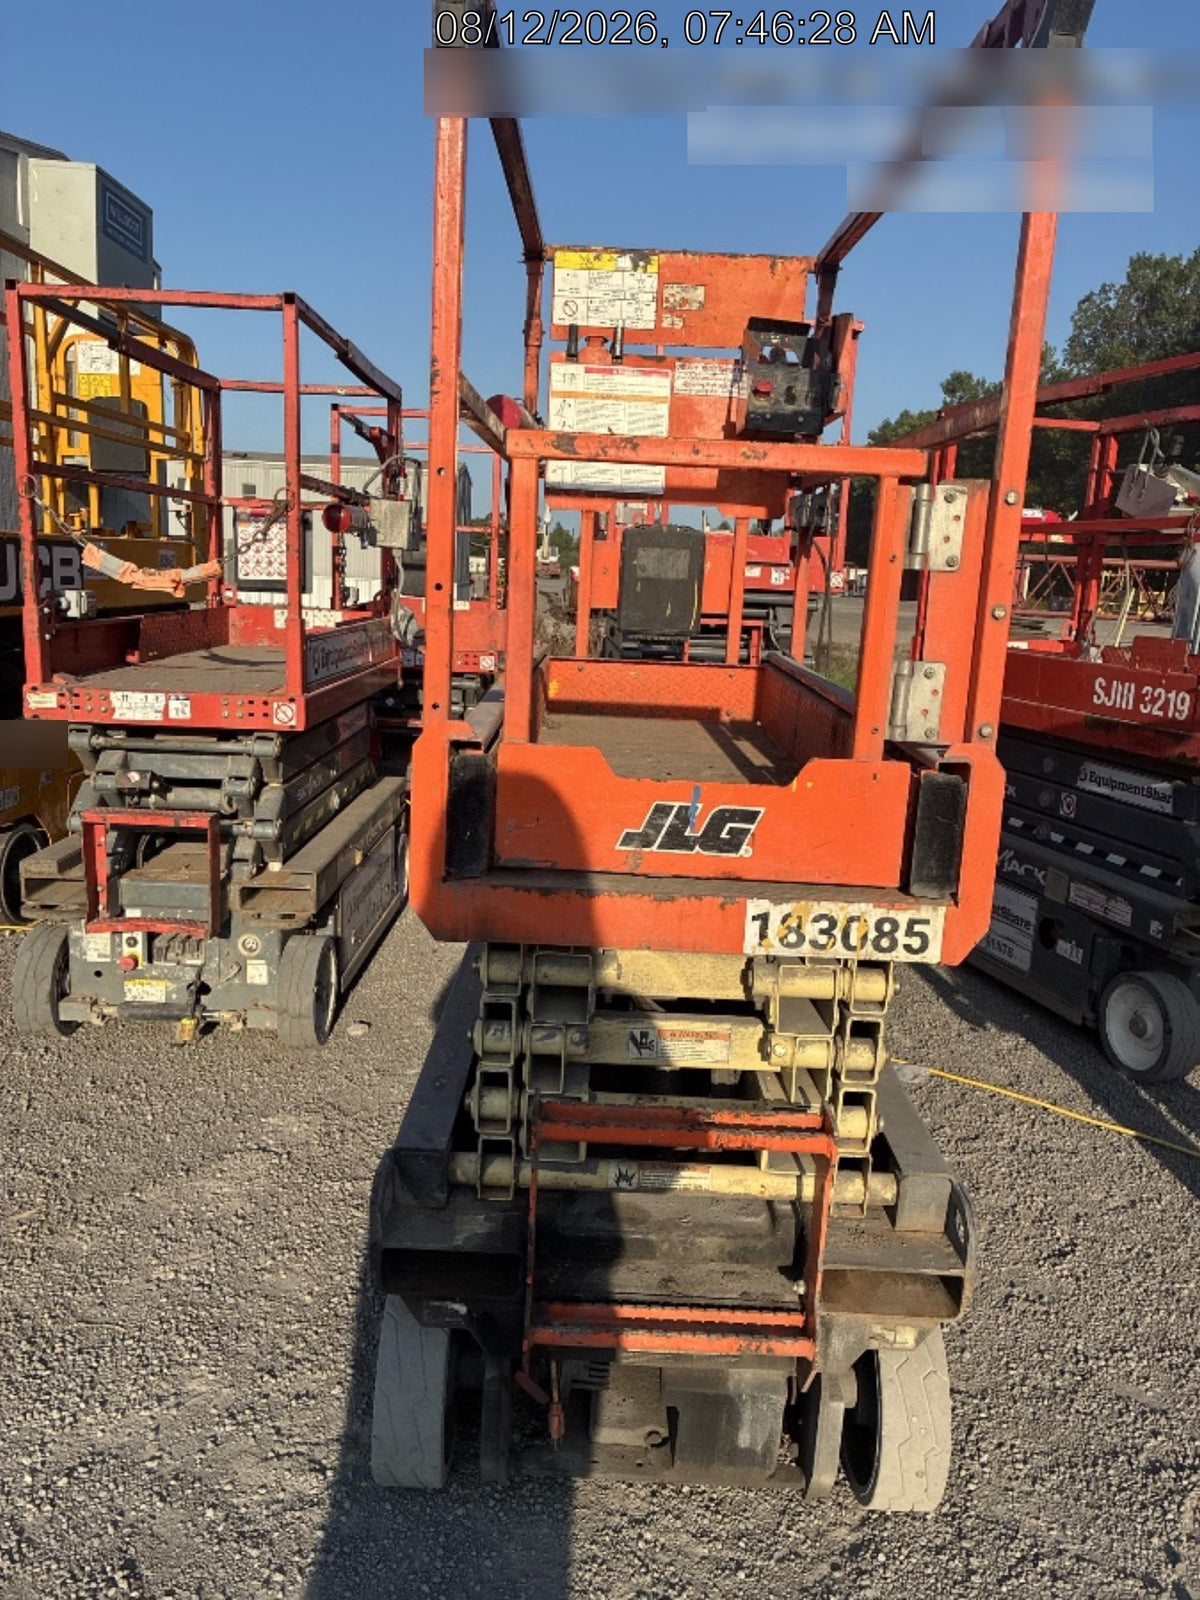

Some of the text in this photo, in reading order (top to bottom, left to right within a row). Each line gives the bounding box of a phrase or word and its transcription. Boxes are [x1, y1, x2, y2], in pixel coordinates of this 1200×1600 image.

[1139, 685, 1190, 720] 3219
[615, 801, 765, 857] JLG
[751, 911, 930, 955] 183085
